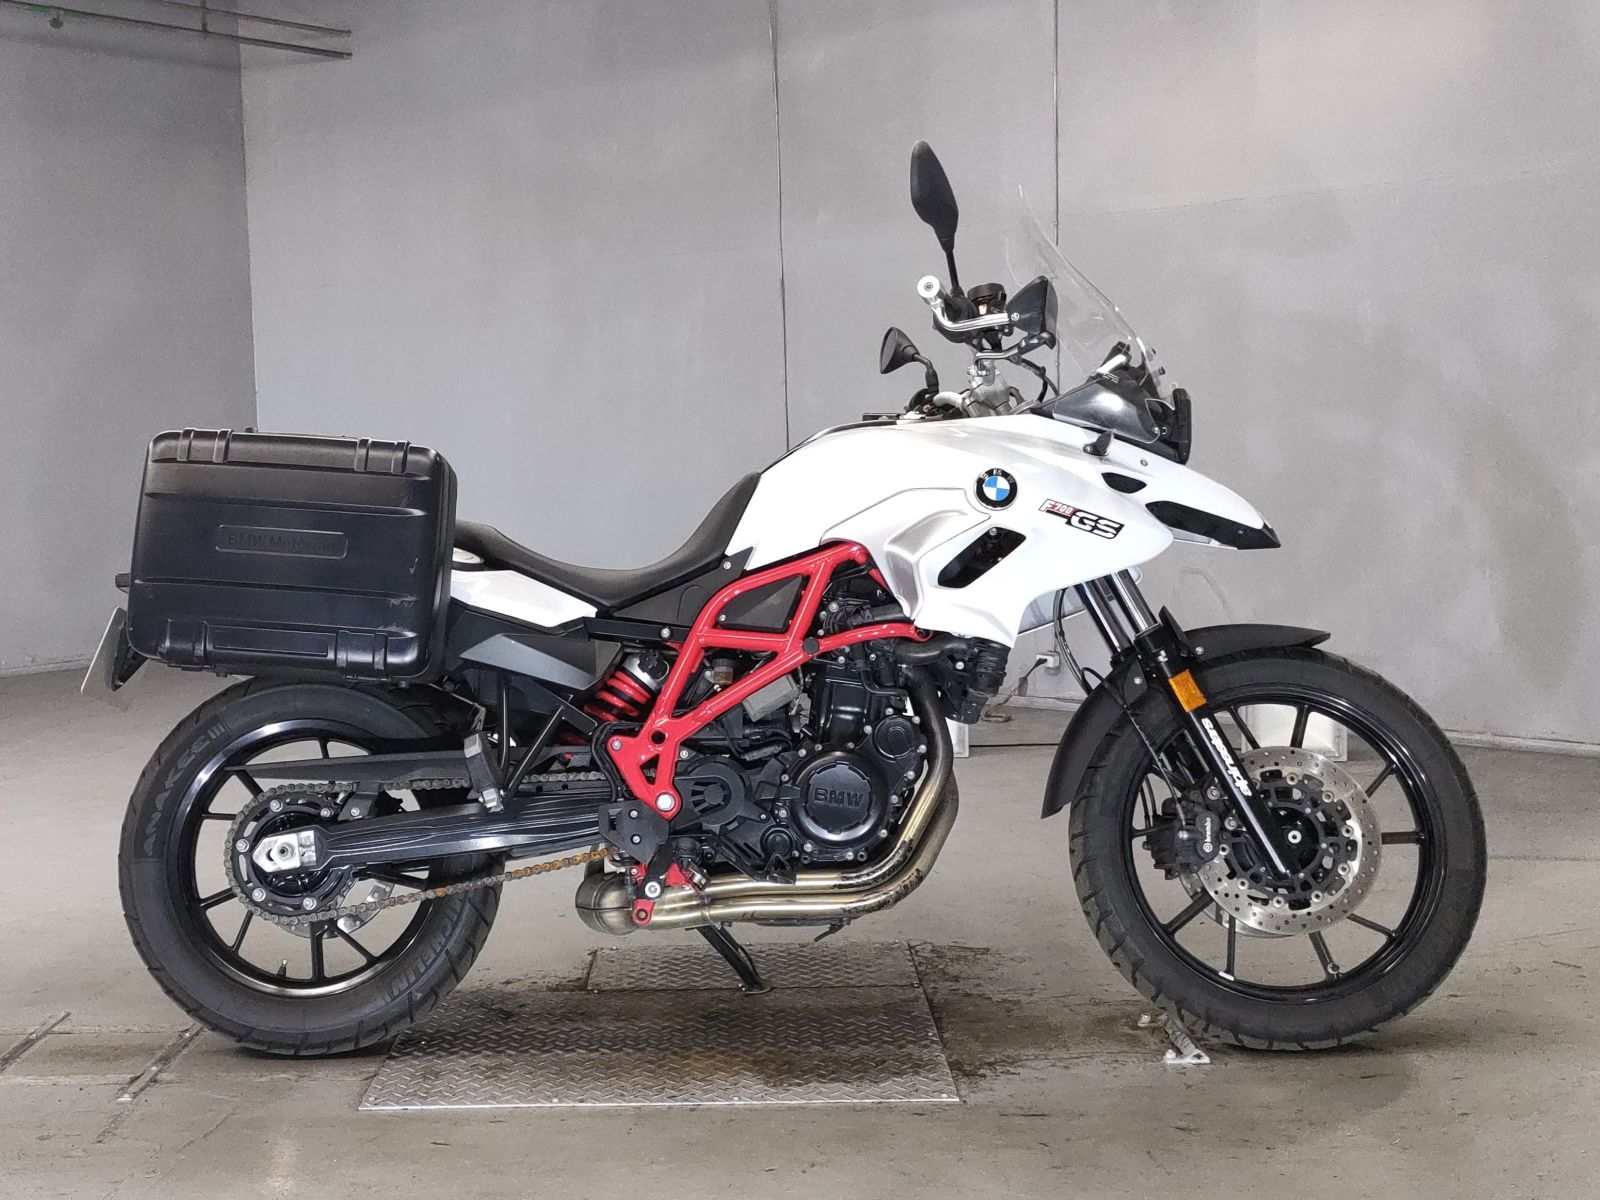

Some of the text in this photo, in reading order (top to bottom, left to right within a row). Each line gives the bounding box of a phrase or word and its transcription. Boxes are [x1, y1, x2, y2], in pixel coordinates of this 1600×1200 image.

[1070, 510, 1123, 539] GS
[227, 533, 263, 548] BMW
[814, 787, 864, 808] BMW
